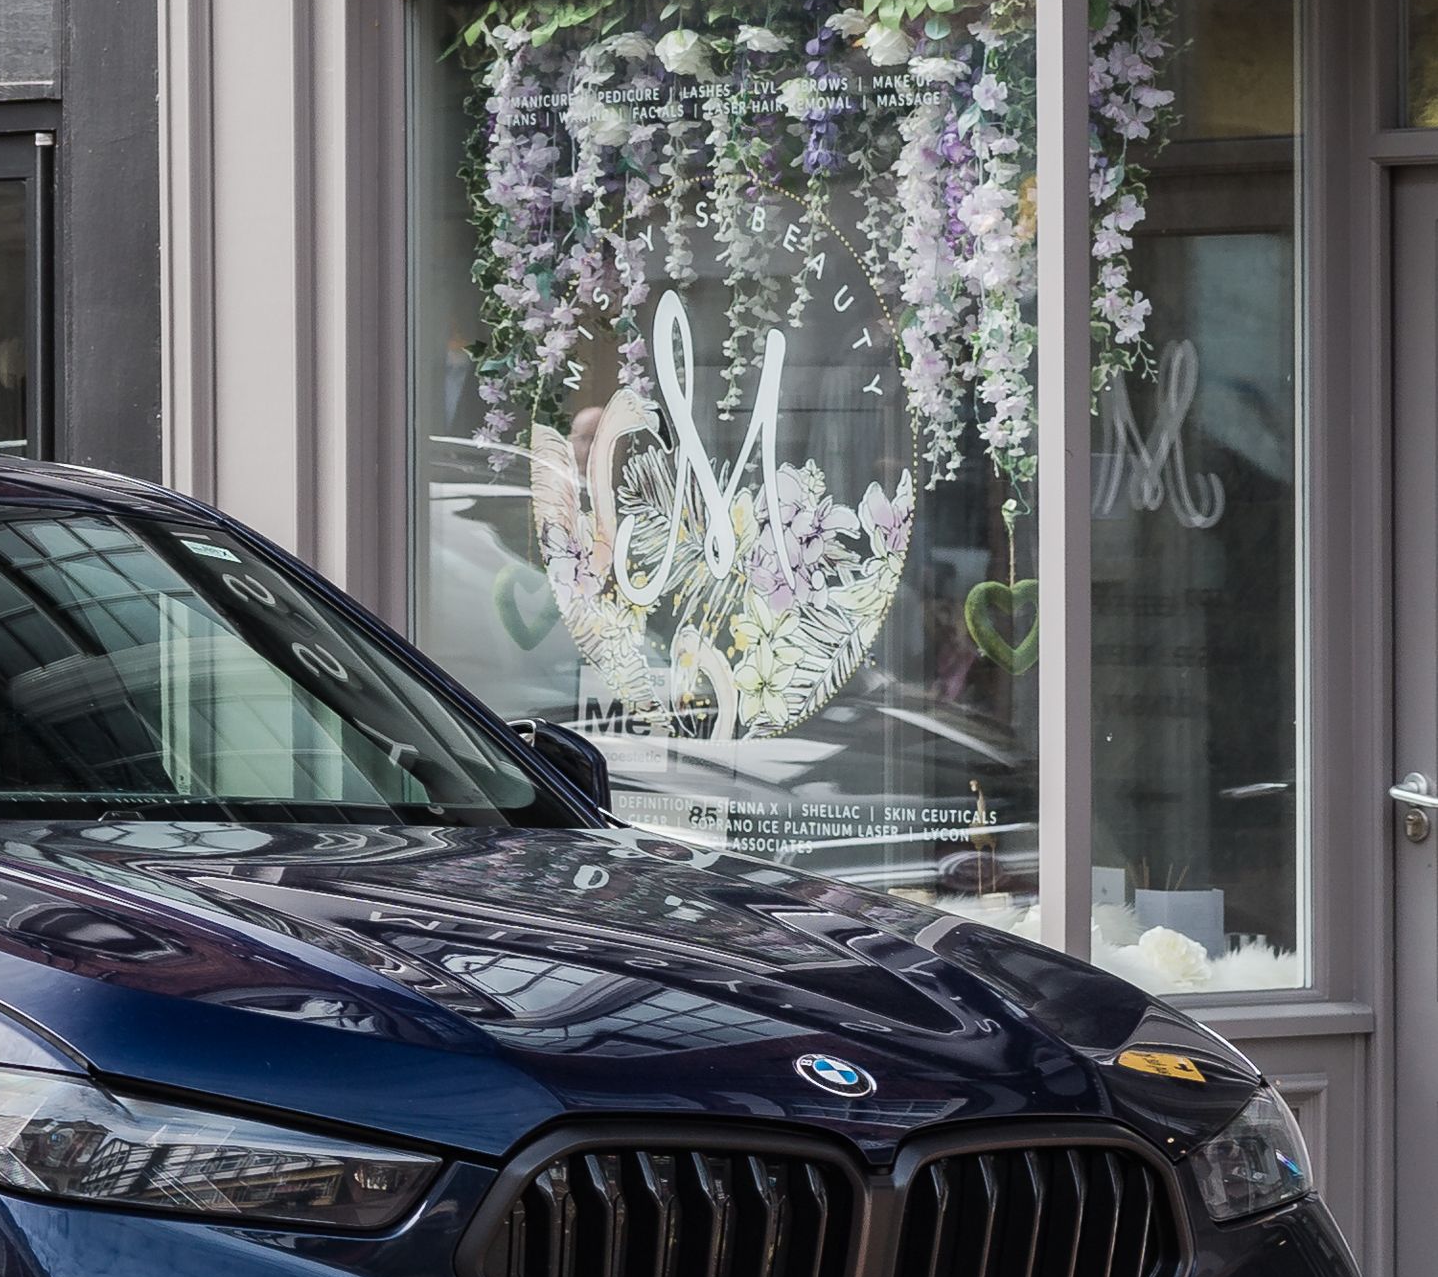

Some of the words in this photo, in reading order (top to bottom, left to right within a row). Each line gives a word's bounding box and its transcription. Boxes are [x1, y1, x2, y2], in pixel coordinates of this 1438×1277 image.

[598, 88, 660, 104] PEDICURE
[683, 83, 731, 99] LASHES
[800, 77, 849, 93] BROWS
[506, 113, 537, 127] TANS
[876, 92, 941, 108] MASSAGE
[751, 206, 883, 396] BEAUTY
[717, 801, 766, 816] SIENNA
[801, 803, 860, 820] SHELLAC
[884, 807, 917, 823] SKIN
[920, 808, 998, 825] CEUTICALS
[691, 818, 753, 833] SOPRANO
[757, 820, 779, 834] ICE
[784, 821, 853, 838] PLATINUM
[857, 824, 899, 839] LASER
[923, 827, 971, 843] LYCON
[731, 837, 814, 854] ASSOCIATES
